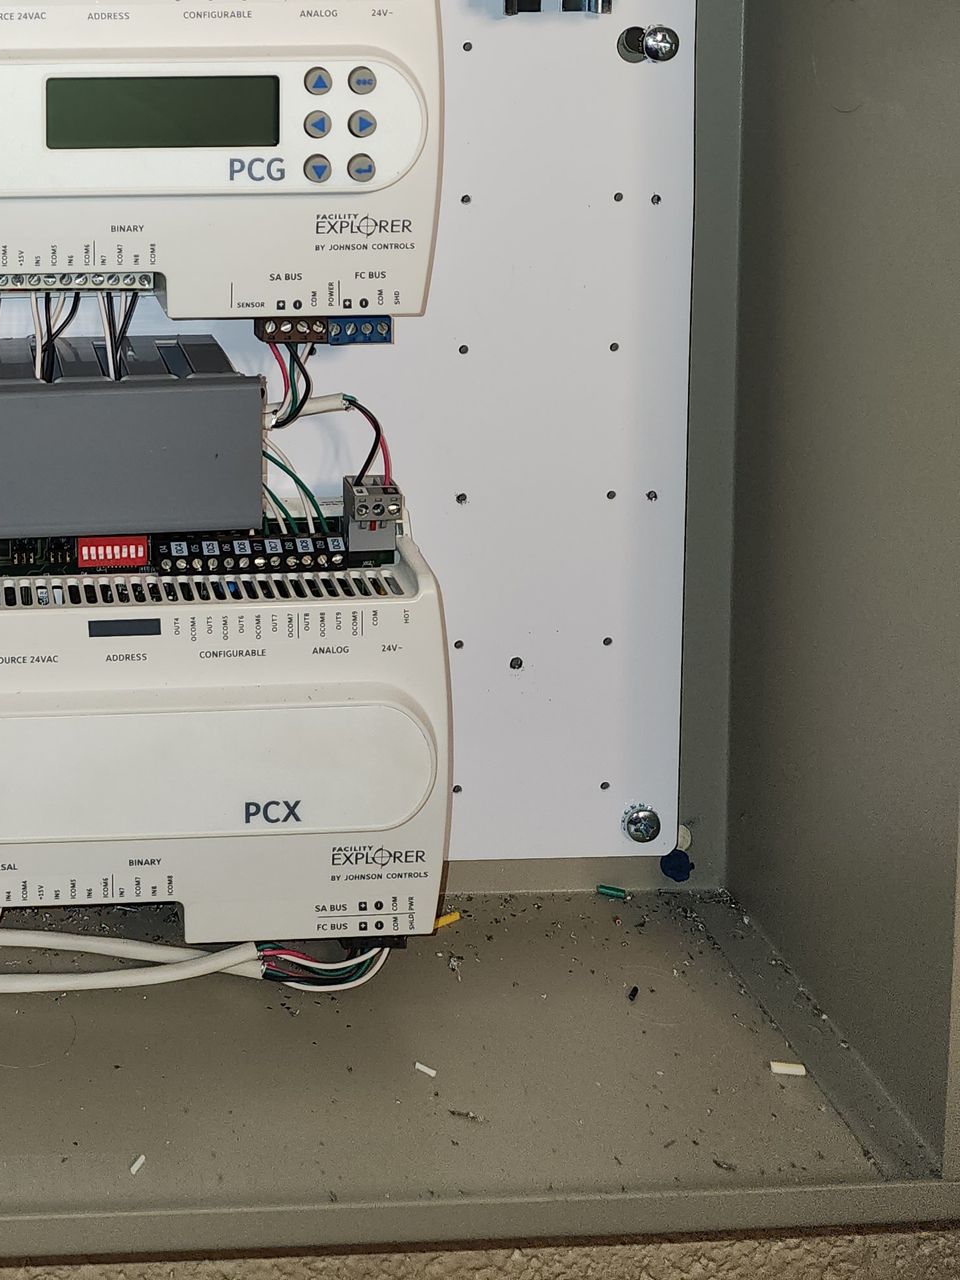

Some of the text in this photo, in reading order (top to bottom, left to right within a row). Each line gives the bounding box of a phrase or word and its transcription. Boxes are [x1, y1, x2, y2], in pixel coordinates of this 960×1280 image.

[18, 12, 46, 20] 24VAC
[88, 12, 129, 20] ADDRESS
[183, 11, 251, 19] CONFIGURABLE
[356, 78, 373, 86] esc
[230, 158, 285, 181] PCG
[316, 216, 412, 236] EXPLORER
[200, 649, 265, 658] CONFIGURABLE
[312, 646, 349, 654] ANALOG
[31, 655, 58, 663] 24VAC
[106, 653, 147, 661] ADDRESS
[245, 800, 301, 823] PCX
[331, 848, 425, 867] EXPLORER
